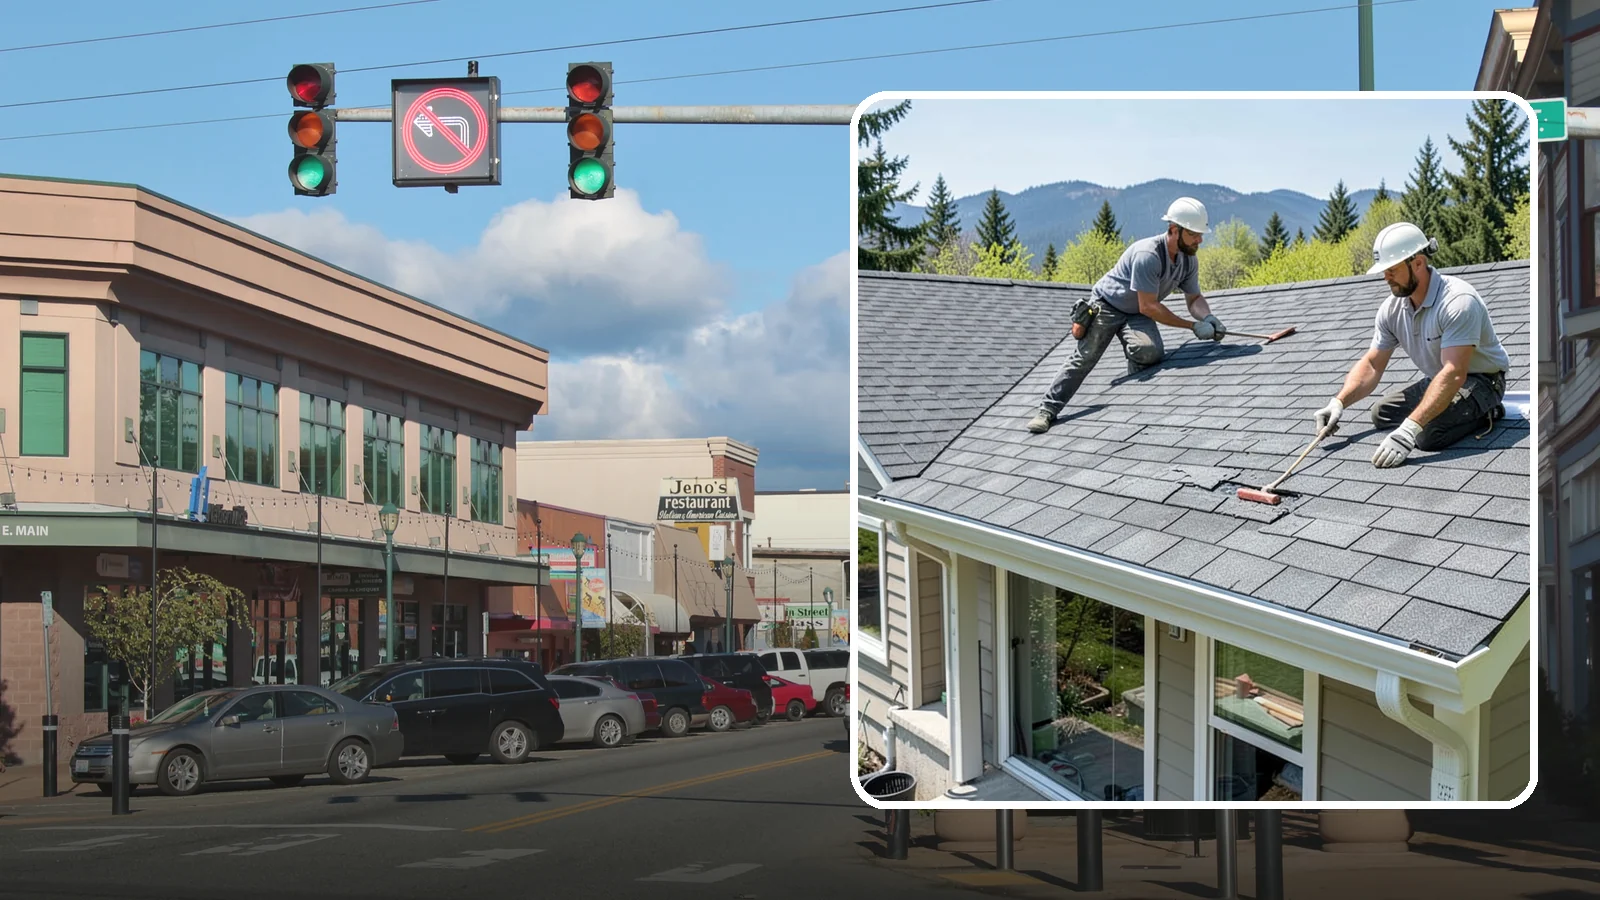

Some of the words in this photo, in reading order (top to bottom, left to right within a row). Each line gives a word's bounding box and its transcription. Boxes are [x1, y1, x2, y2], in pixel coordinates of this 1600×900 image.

[670, 480, 727, 494] Jeno's
[665, 497, 731, 509] restaurant
[658, 509, 681, 520] Italian
[686, 509, 714, 519] American
[715, 509, 737, 519] Cuisine
[2, 525, 13, 536] E.
[15, 525, 49, 536] MAIN
[797, 607, 828, 617] Street
[791, 619, 824, 627] lass
